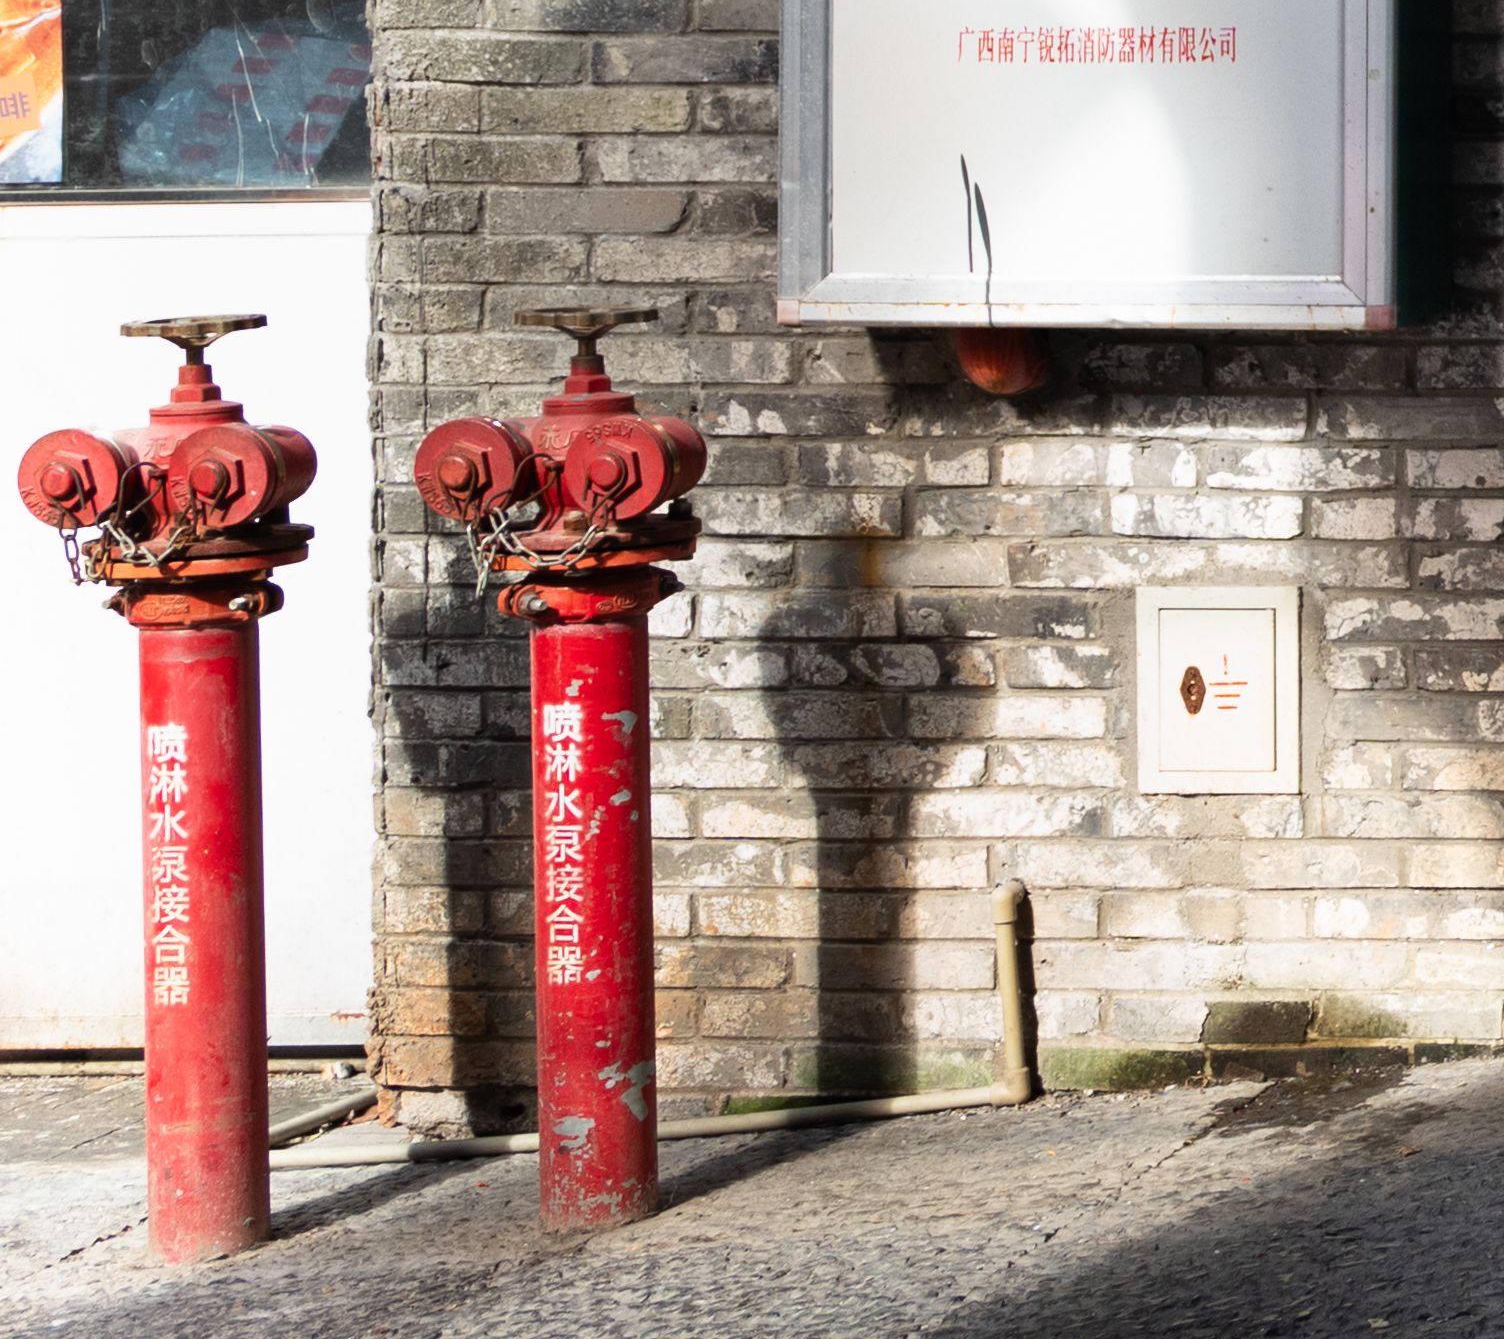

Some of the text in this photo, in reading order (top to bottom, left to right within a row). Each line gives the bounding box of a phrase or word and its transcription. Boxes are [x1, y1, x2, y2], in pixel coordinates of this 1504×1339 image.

[957, 26, 1238, 64] 广西南宁锐拓消防器材有限公司
[147, 723, 190, 1005] 喷淋水泵接合器
[542, 701, 583, 985] 喷淋水泵接合器
